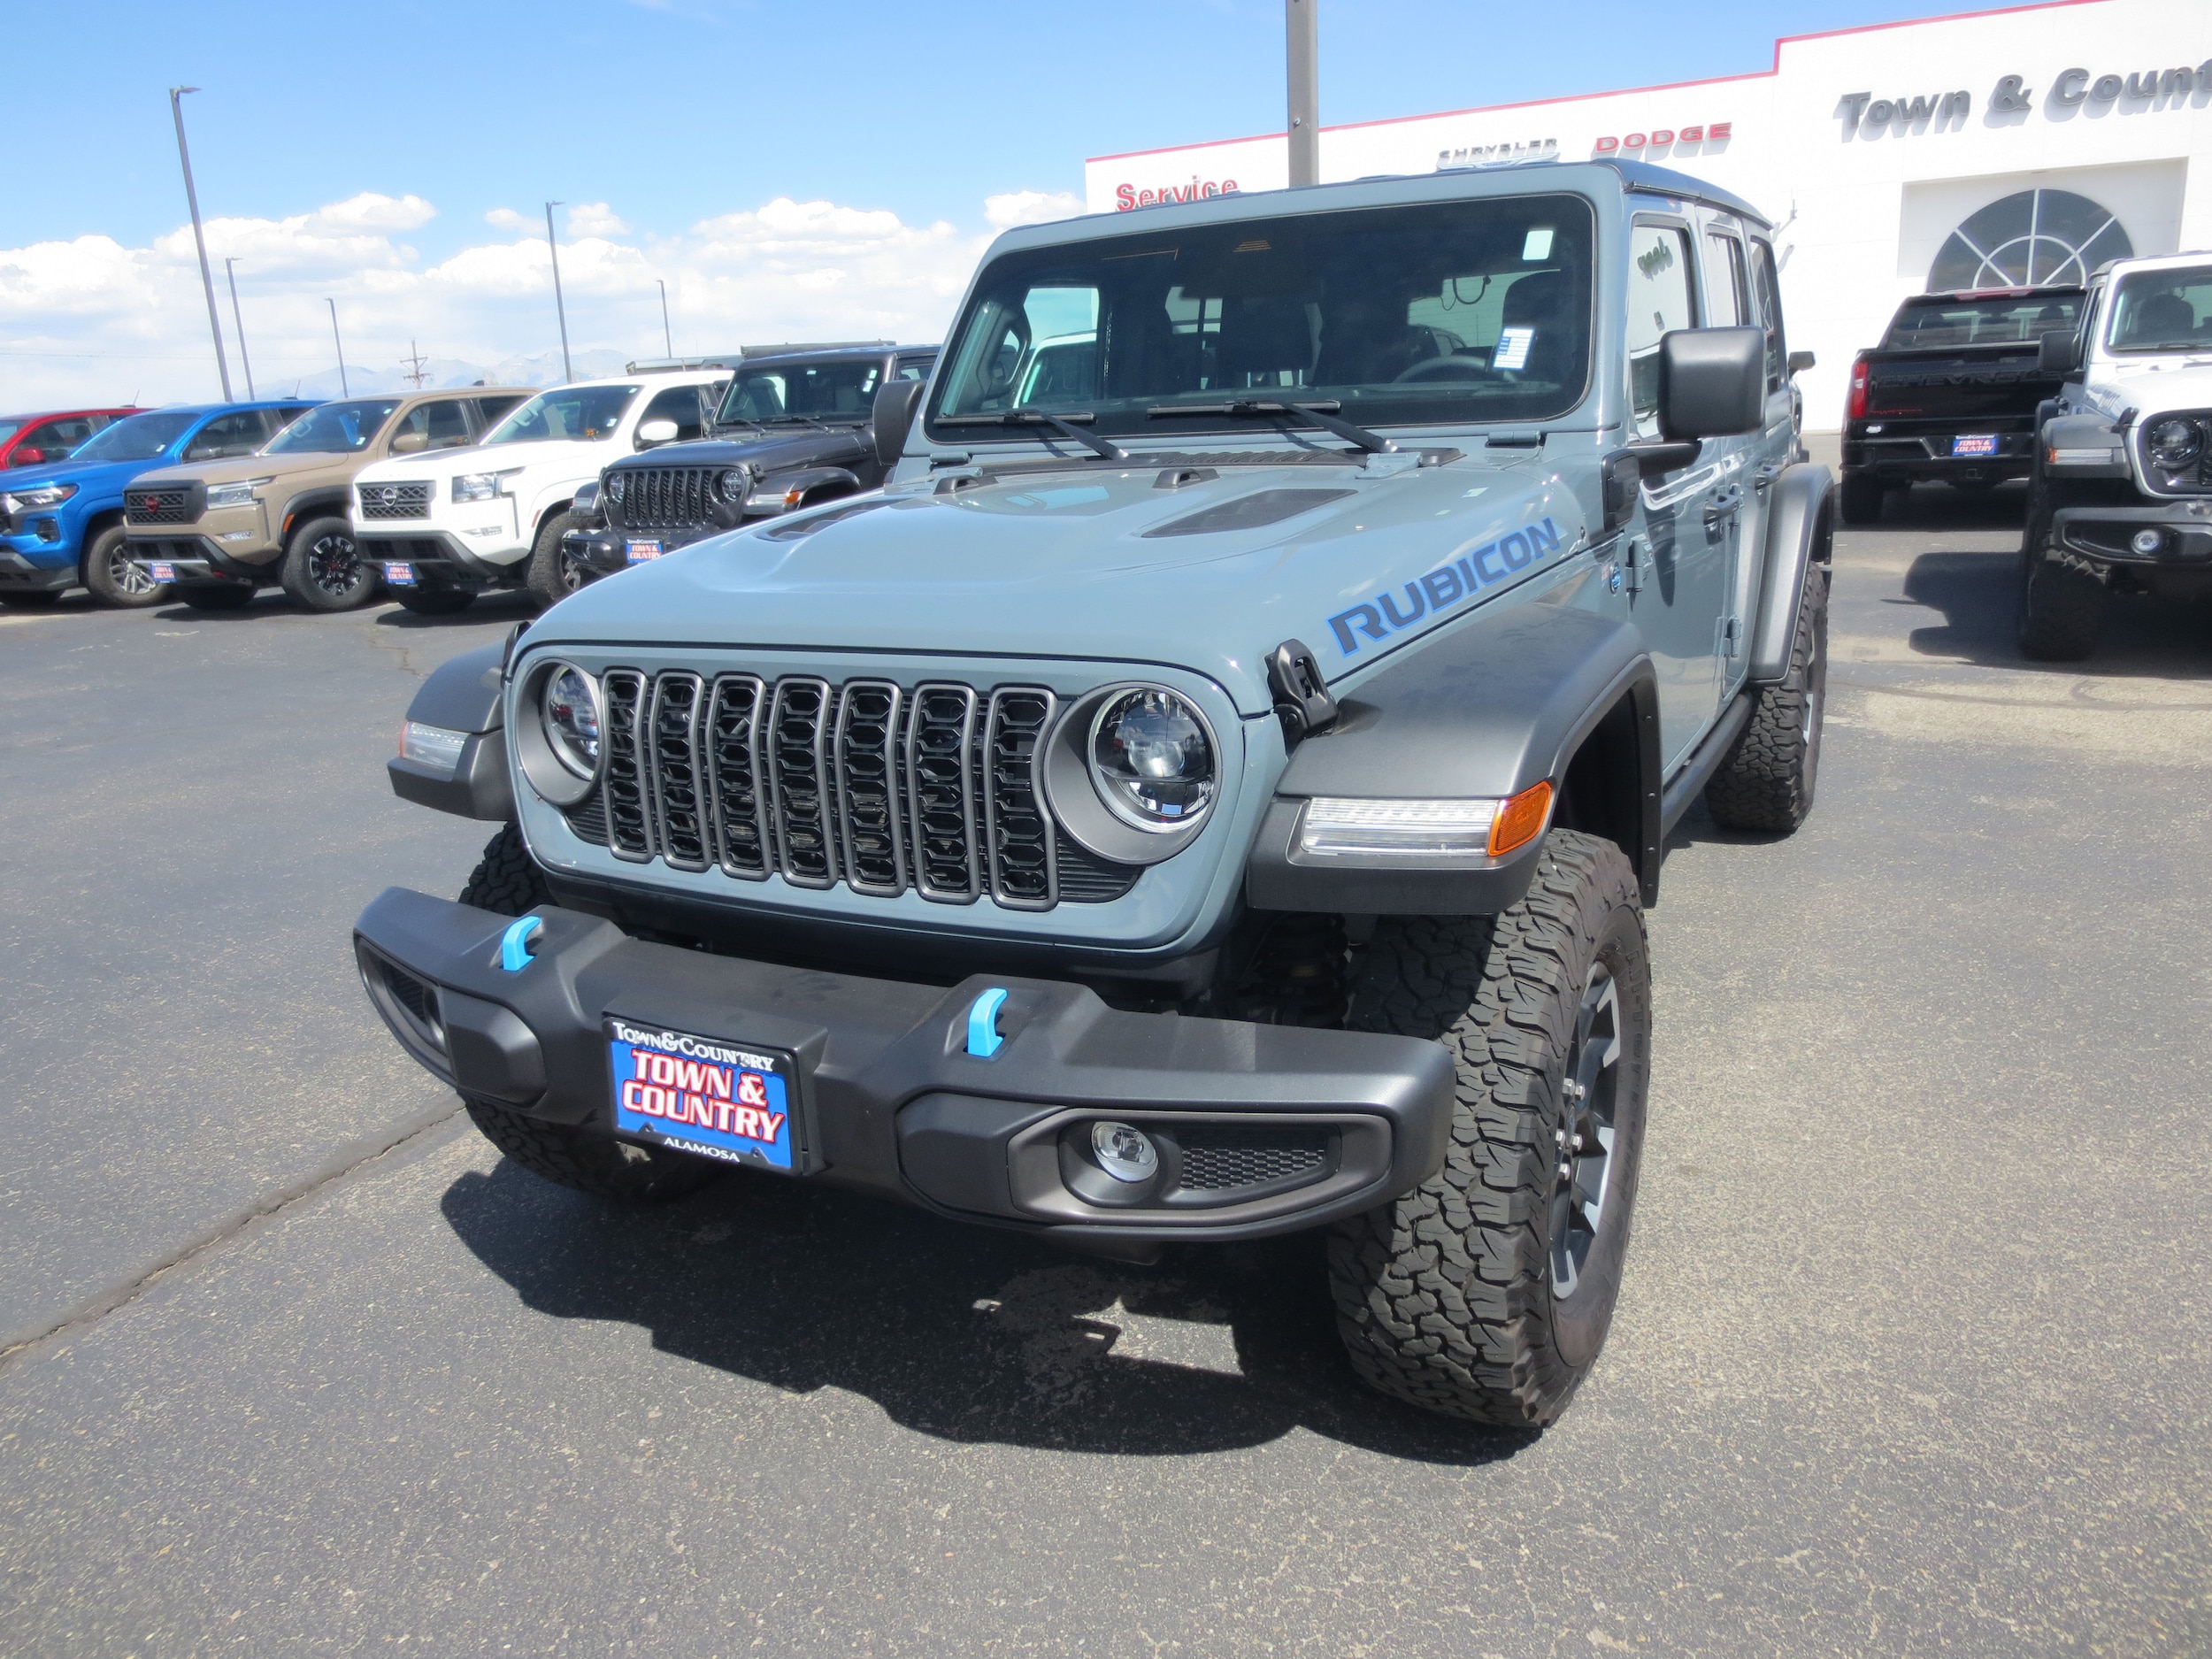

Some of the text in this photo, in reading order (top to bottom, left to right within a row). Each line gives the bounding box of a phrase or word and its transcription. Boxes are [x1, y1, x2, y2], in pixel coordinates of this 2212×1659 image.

[1840, 89, 1971, 127] Town
[1993, 74, 2033, 111] &
[1439, 138, 1557, 158] CHRYSLER
[1595, 122, 1732, 153] DODGE
[1116, 175, 1238, 211] Service
[1325, 517, 1561, 658] RUBICON
[631, 1048, 768, 1107] TOWN &
[622, 1079, 785, 1143] COUNTRY
[664, 1137, 741, 1164] ALAMOSA
